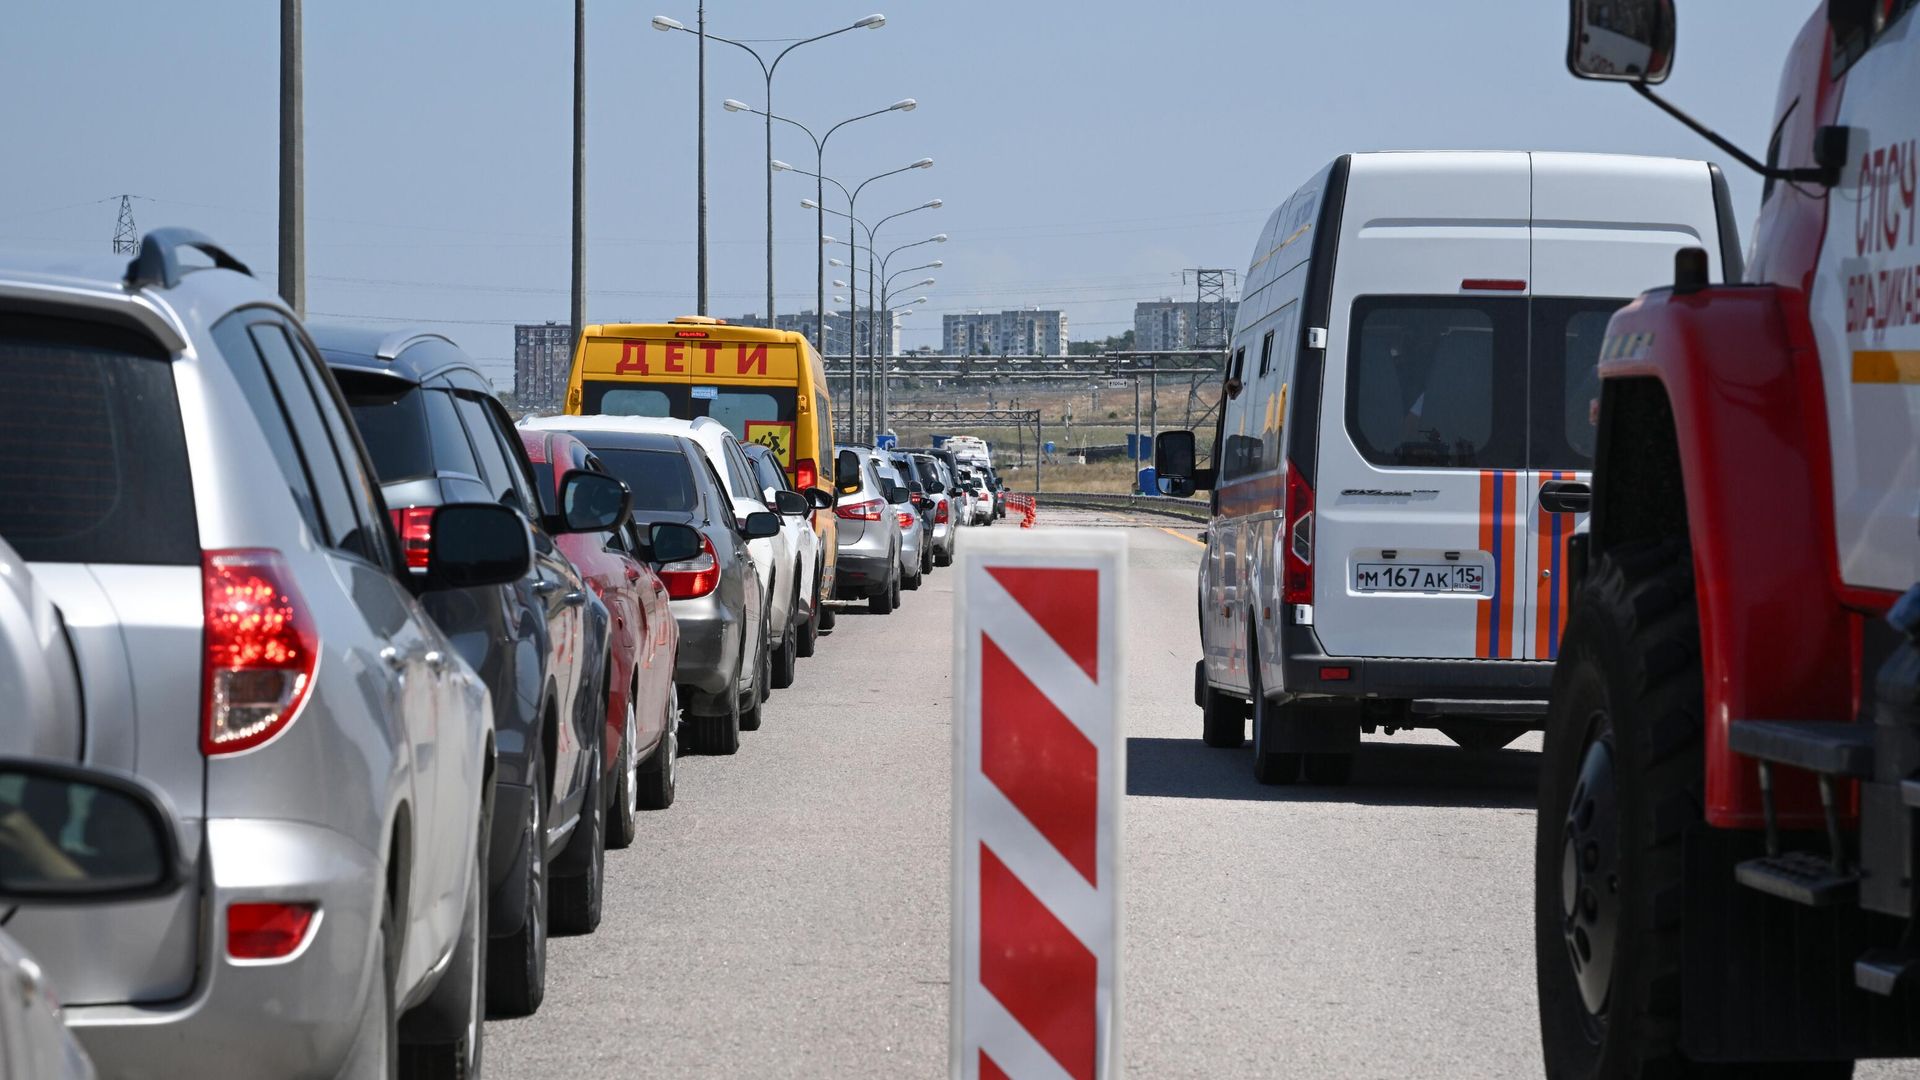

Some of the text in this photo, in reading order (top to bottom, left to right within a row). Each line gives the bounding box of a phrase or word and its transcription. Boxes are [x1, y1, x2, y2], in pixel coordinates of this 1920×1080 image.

[1856, 139, 1917, 257] СПСЧ
[616, 340, 767, 376] ДЕТИ
[1456, 567, 1475, 583] 15
